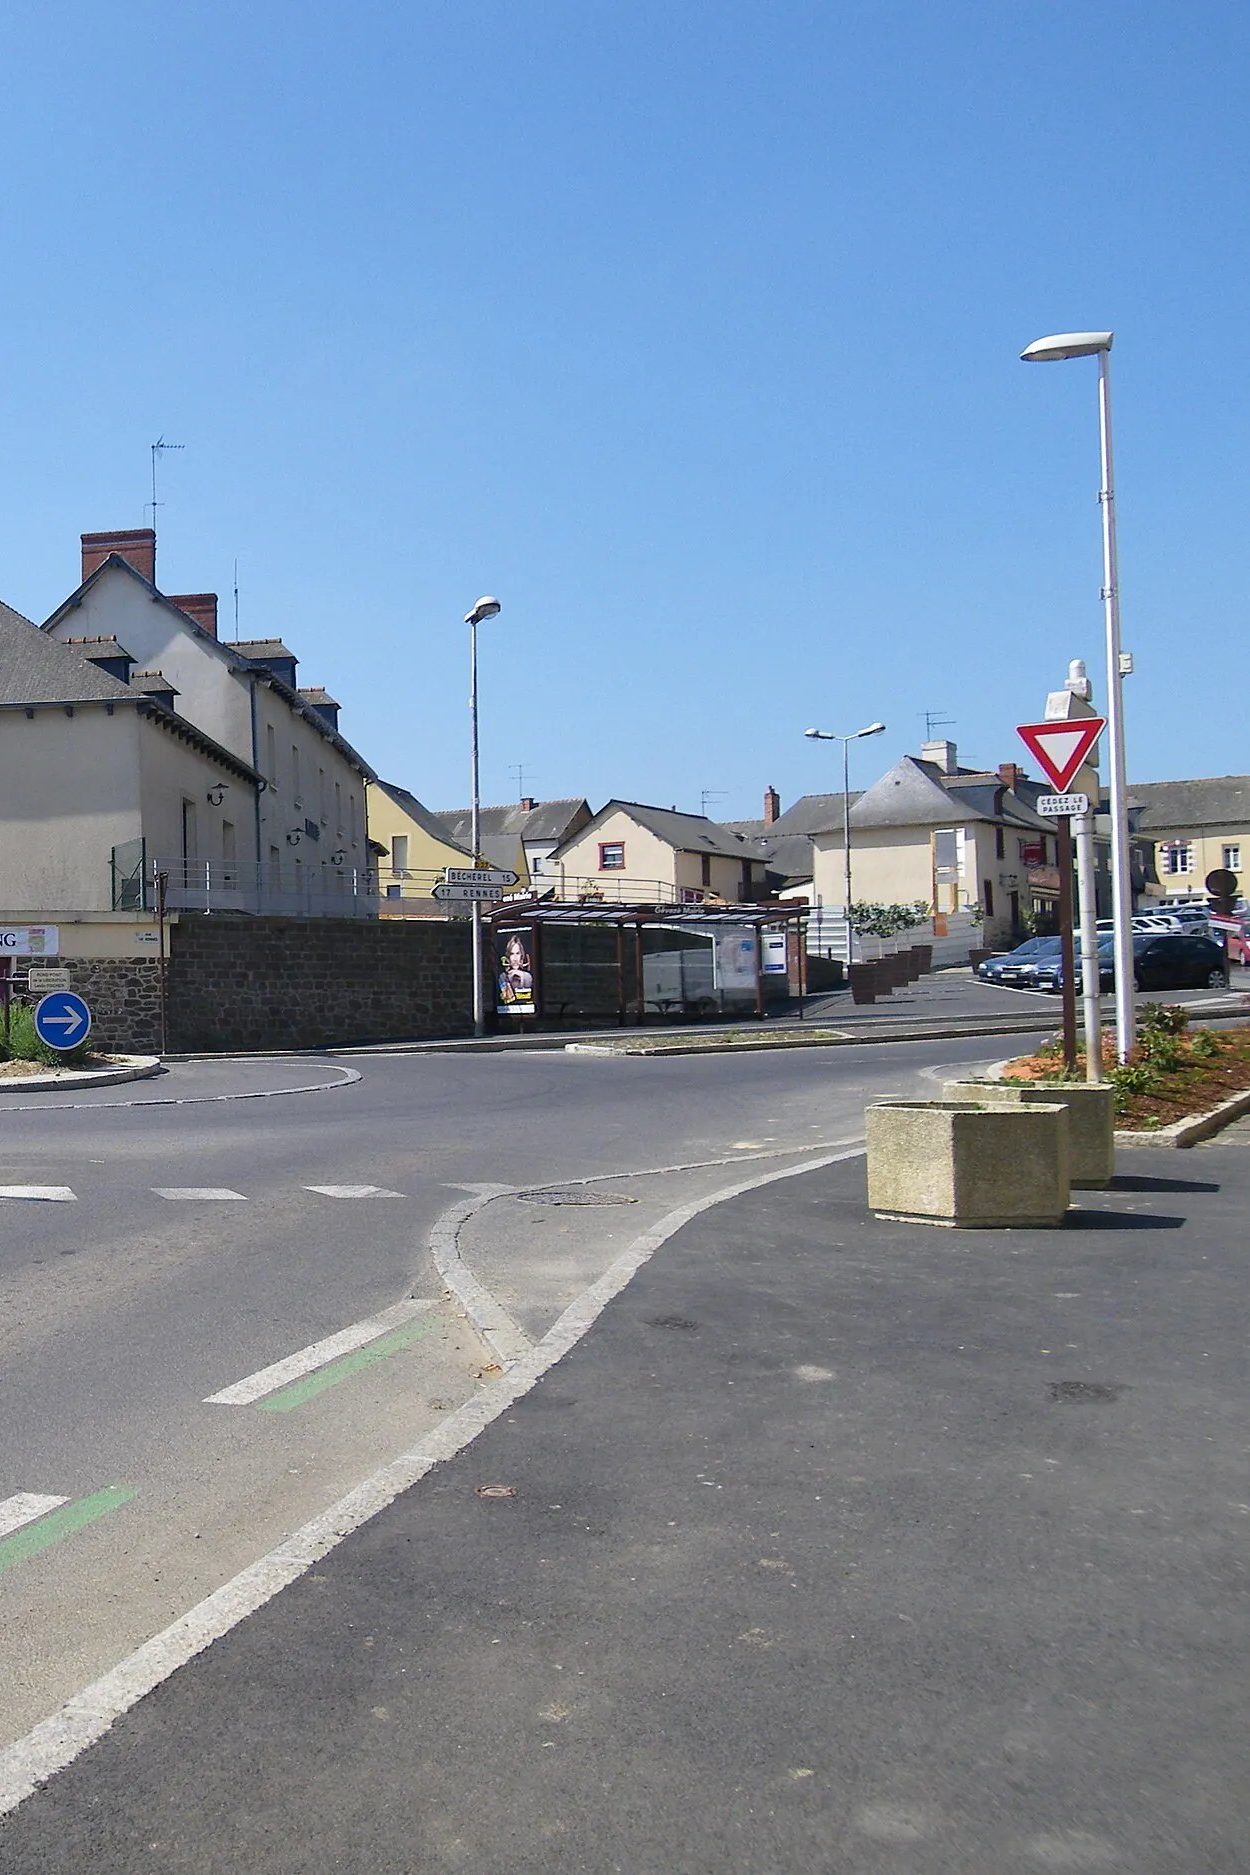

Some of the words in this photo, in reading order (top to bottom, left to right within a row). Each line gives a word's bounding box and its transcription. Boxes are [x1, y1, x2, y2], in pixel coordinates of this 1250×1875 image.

[1073, 796, 1083, 804] LE
[1042, 804, 1082, 812] PASSAGE
[450, 871, 492, 882] BÉCHEREL
[502, 874, 511, 882] 15
[441, 889, 451, 897] 17
[463, 889, 500, 899] RENNES
